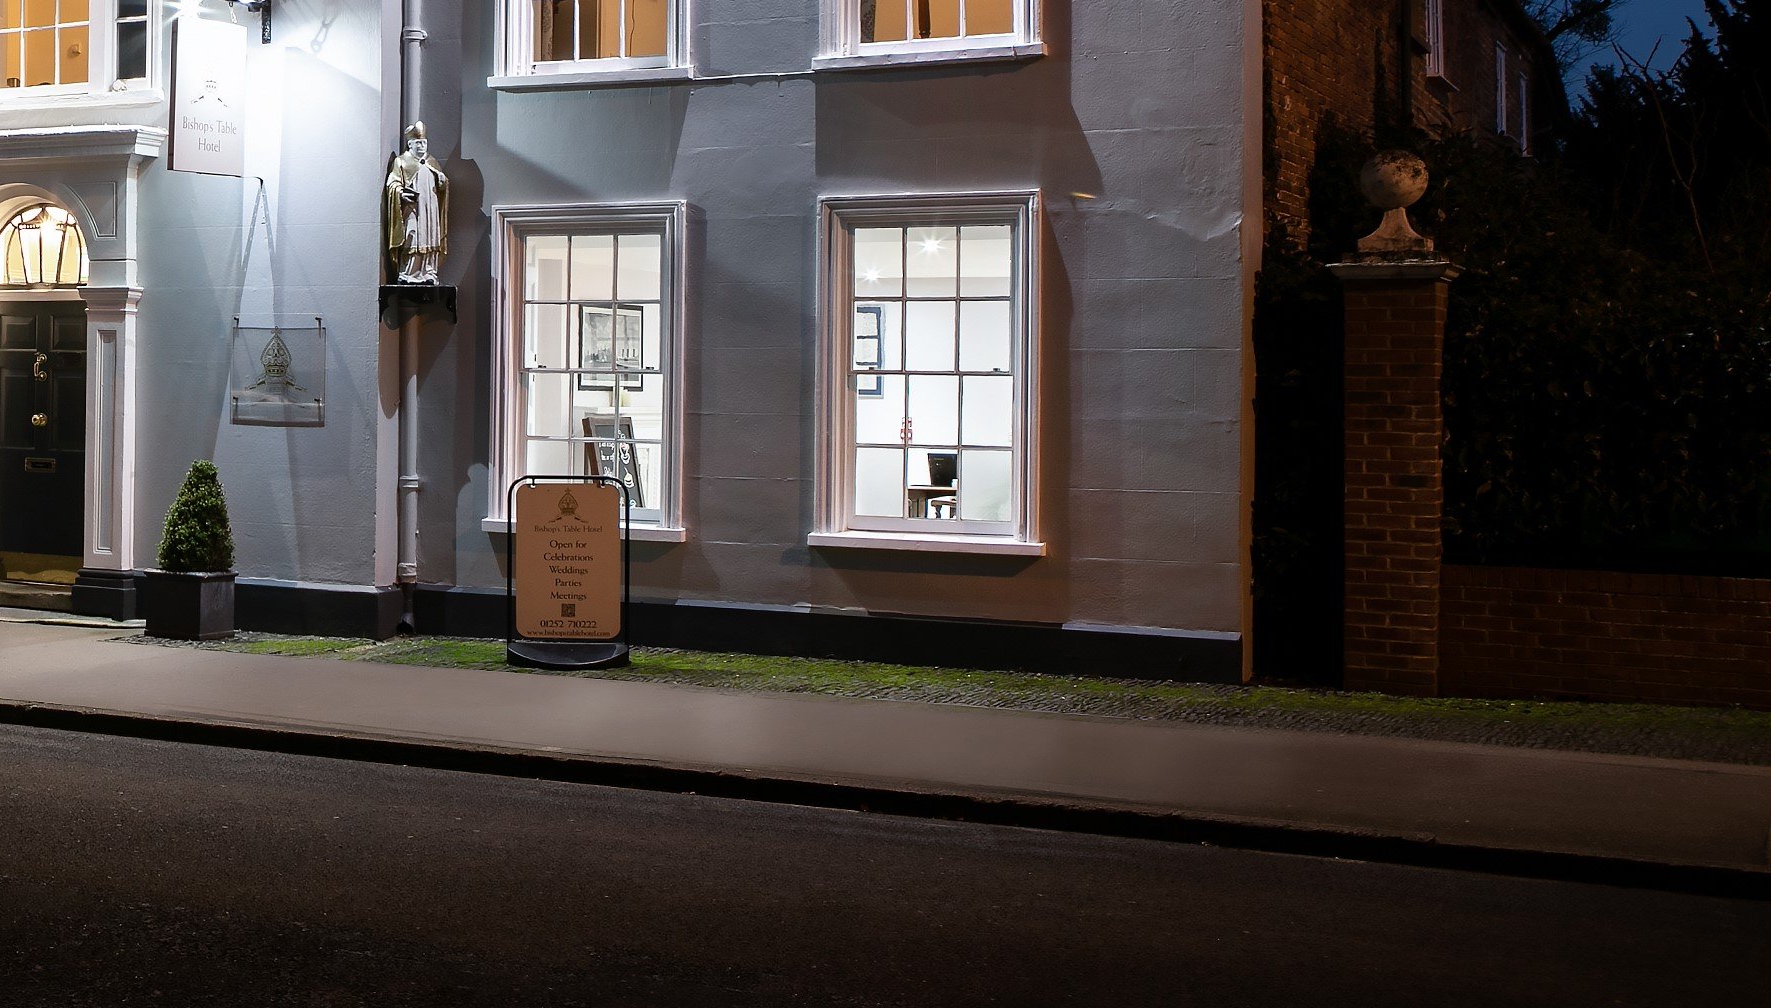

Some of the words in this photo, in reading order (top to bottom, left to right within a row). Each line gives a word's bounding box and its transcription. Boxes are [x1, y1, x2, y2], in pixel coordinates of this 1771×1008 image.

[182, 116, 214, 133] Bishop's
[215, 120, 237, 135] Table
[198, 138, 221, 152] Hotel
[534, 525, 561, 534] Bishop's
[561, 525, 581, 533] Table
[582, 525, 603, 533] Hotel
[549, 539, 573, 549] Open
[575, 539, 587, 548] for
[543, 552, 593, 561] Celebrations
[548, 565, 588, 575] Weddings
[554, 578, 582, 587] Parties
[549, 591, 587, 601] Meetings
[539, 619, 564, 628] 01252
[567, 619, 597, 628] 710222
